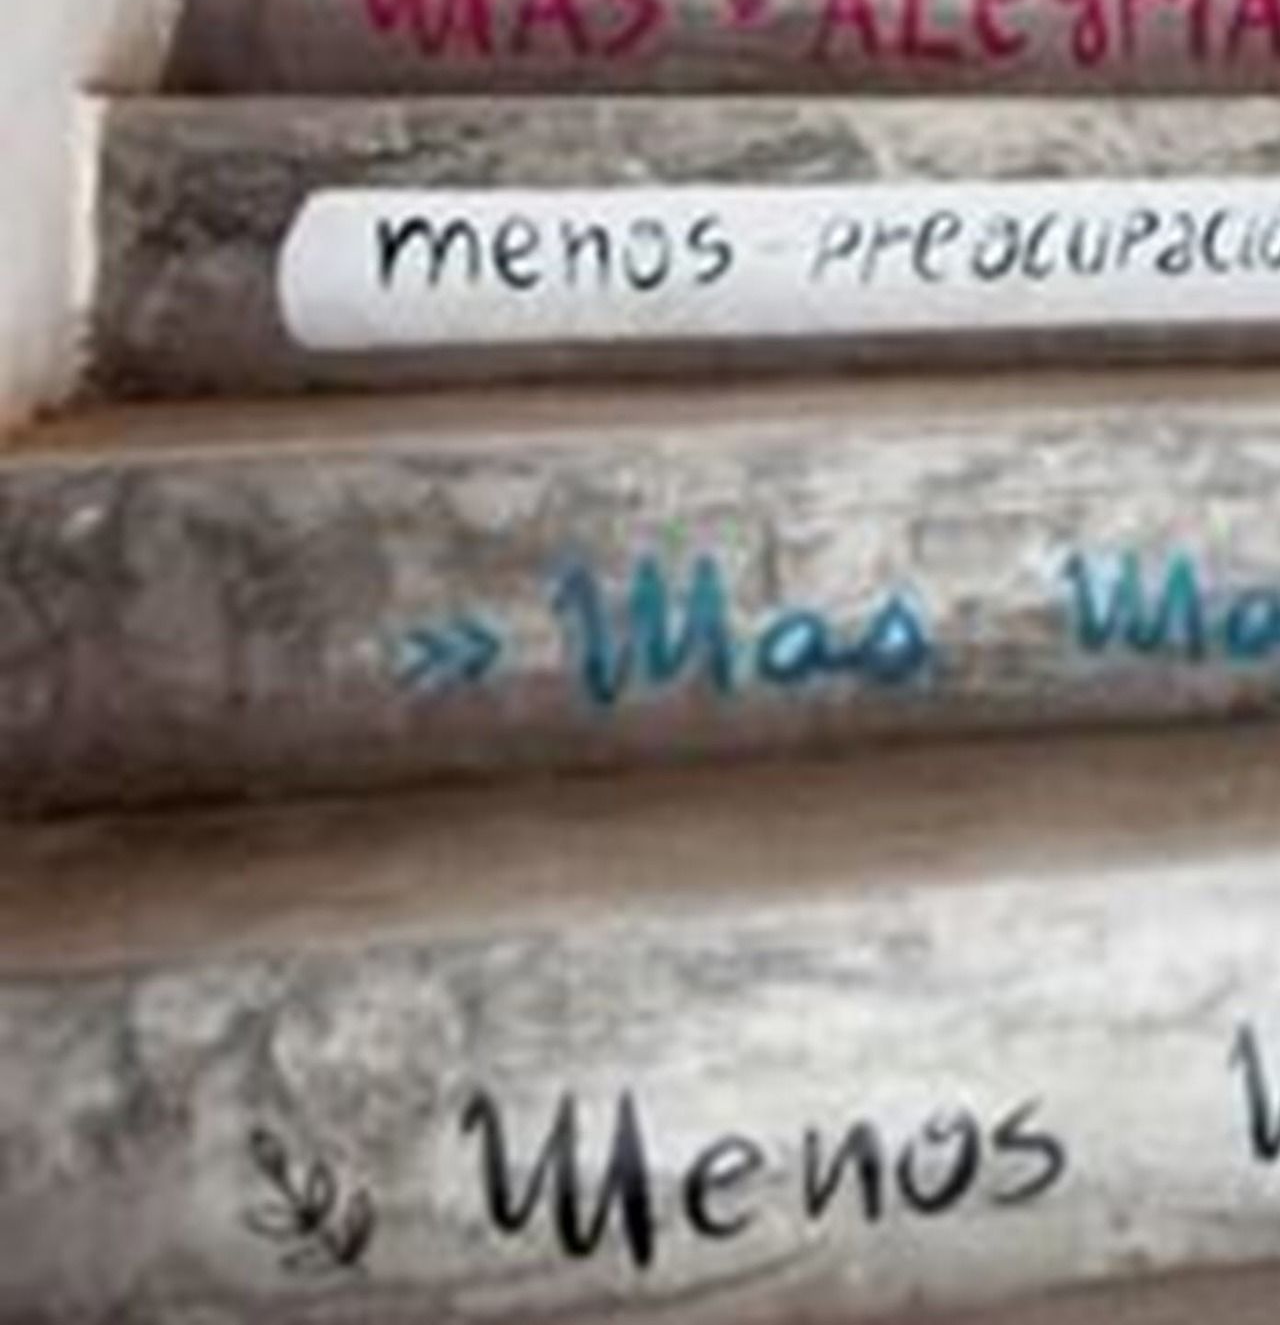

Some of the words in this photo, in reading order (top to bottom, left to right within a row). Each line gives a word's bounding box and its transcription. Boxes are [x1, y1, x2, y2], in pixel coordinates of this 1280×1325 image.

[375, 210, 734, 290] menos
[550, 556, 930, 704] Mas
[460, 1088, 1068, 1266] Menos
